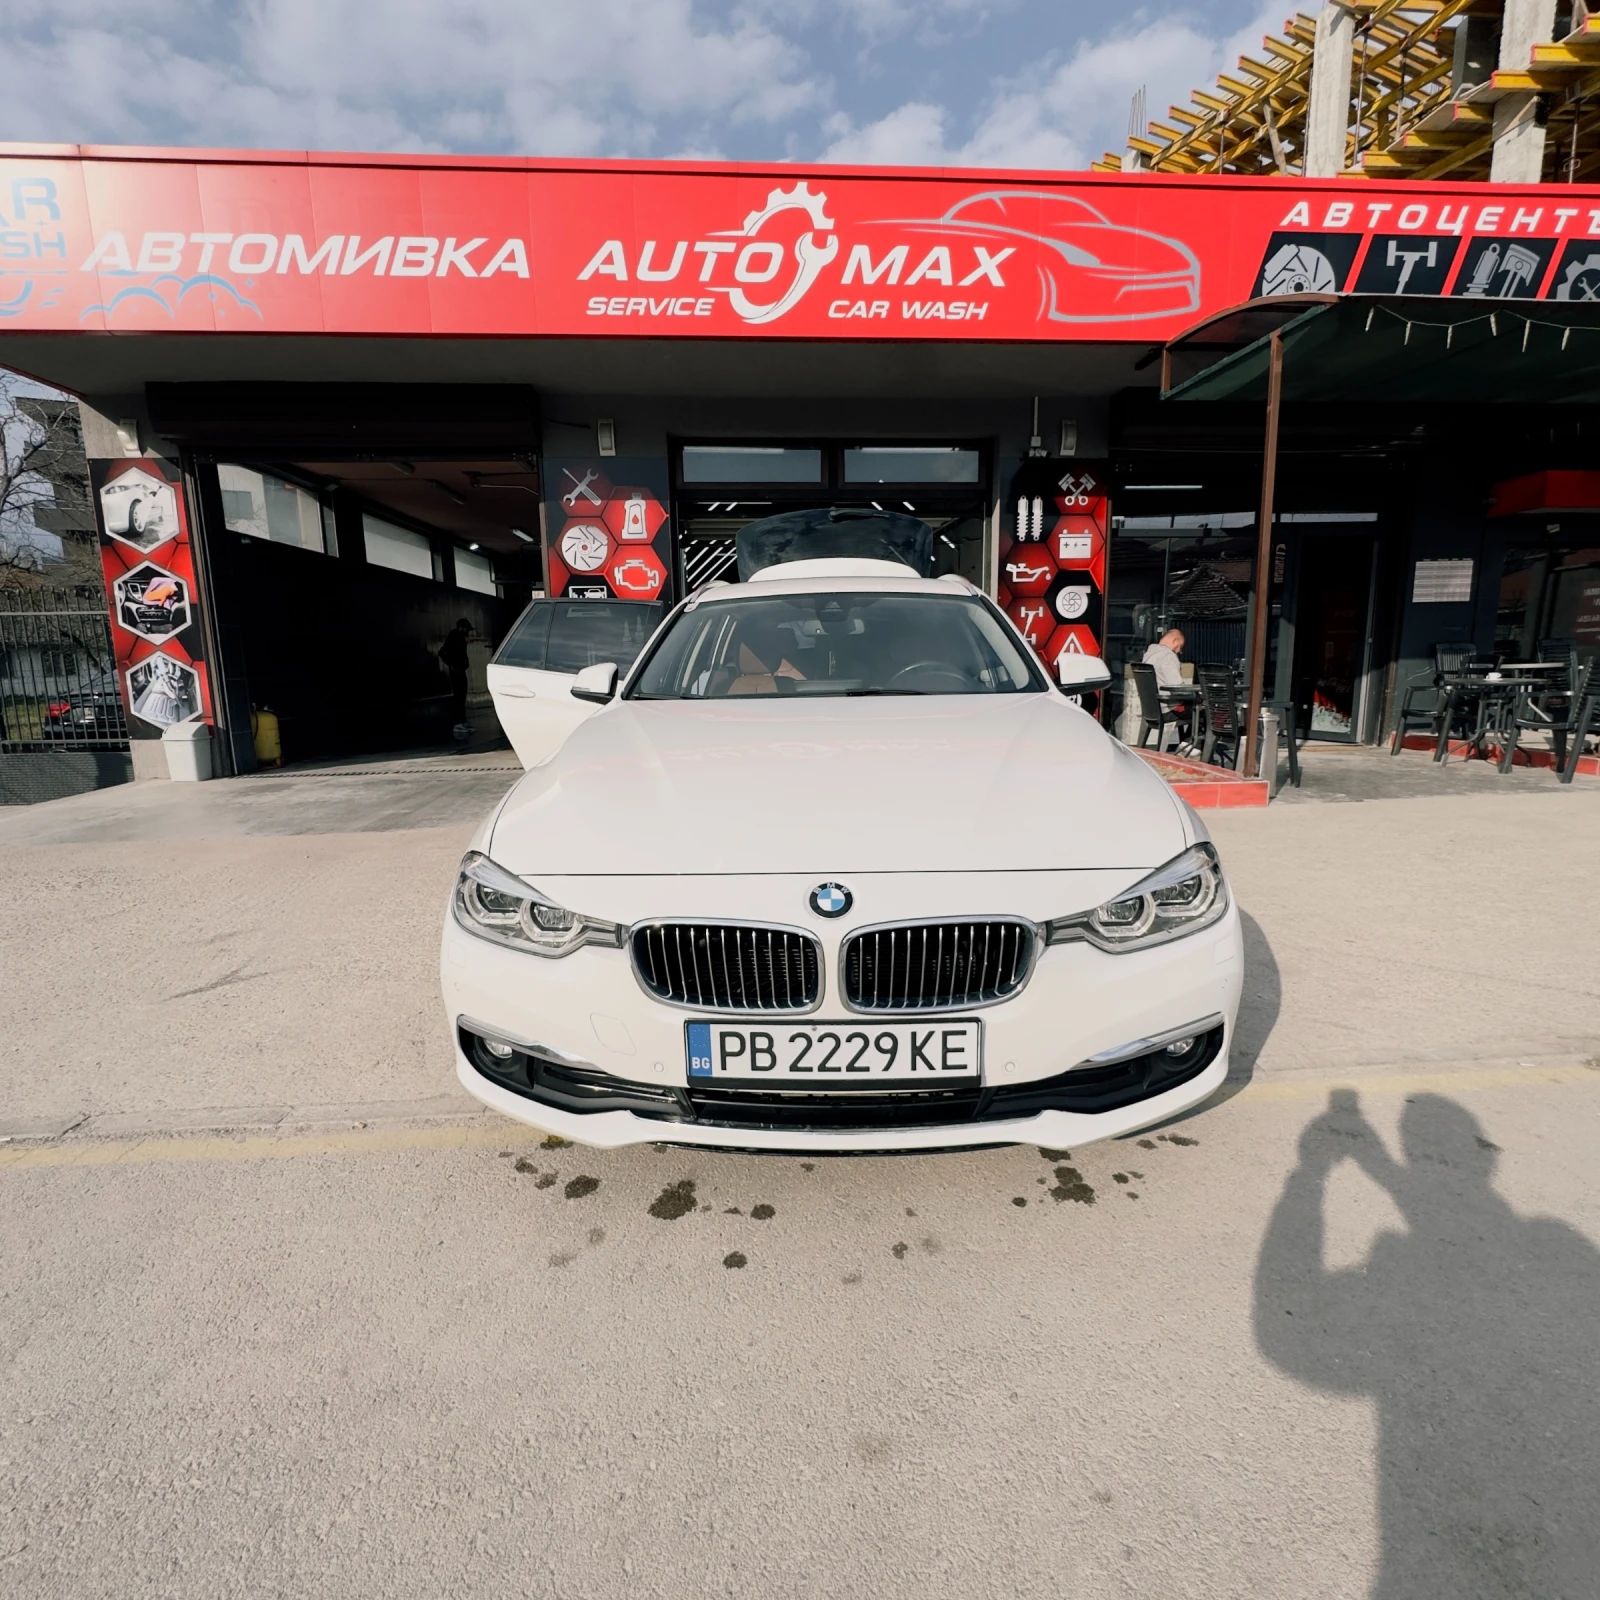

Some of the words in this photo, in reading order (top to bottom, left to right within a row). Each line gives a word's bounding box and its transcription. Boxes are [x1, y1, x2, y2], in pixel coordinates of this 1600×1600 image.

[79, 230, 530, 278] АВТОМИВКА
[576, 240, 784, 282] AUTO
[840, 244, 1017, 287] MAX
[586, 297, 715, 316] SERVICE
[827, 300, 890, 319] CAR
[902, 301, 988, 320] WASH
[691, 1056, 711, 1069] BG
[719, 1031, 777, 1071] PB
[788, 1031, 898, 1072] 2229
[910, 1030, 968, 1071] KE
